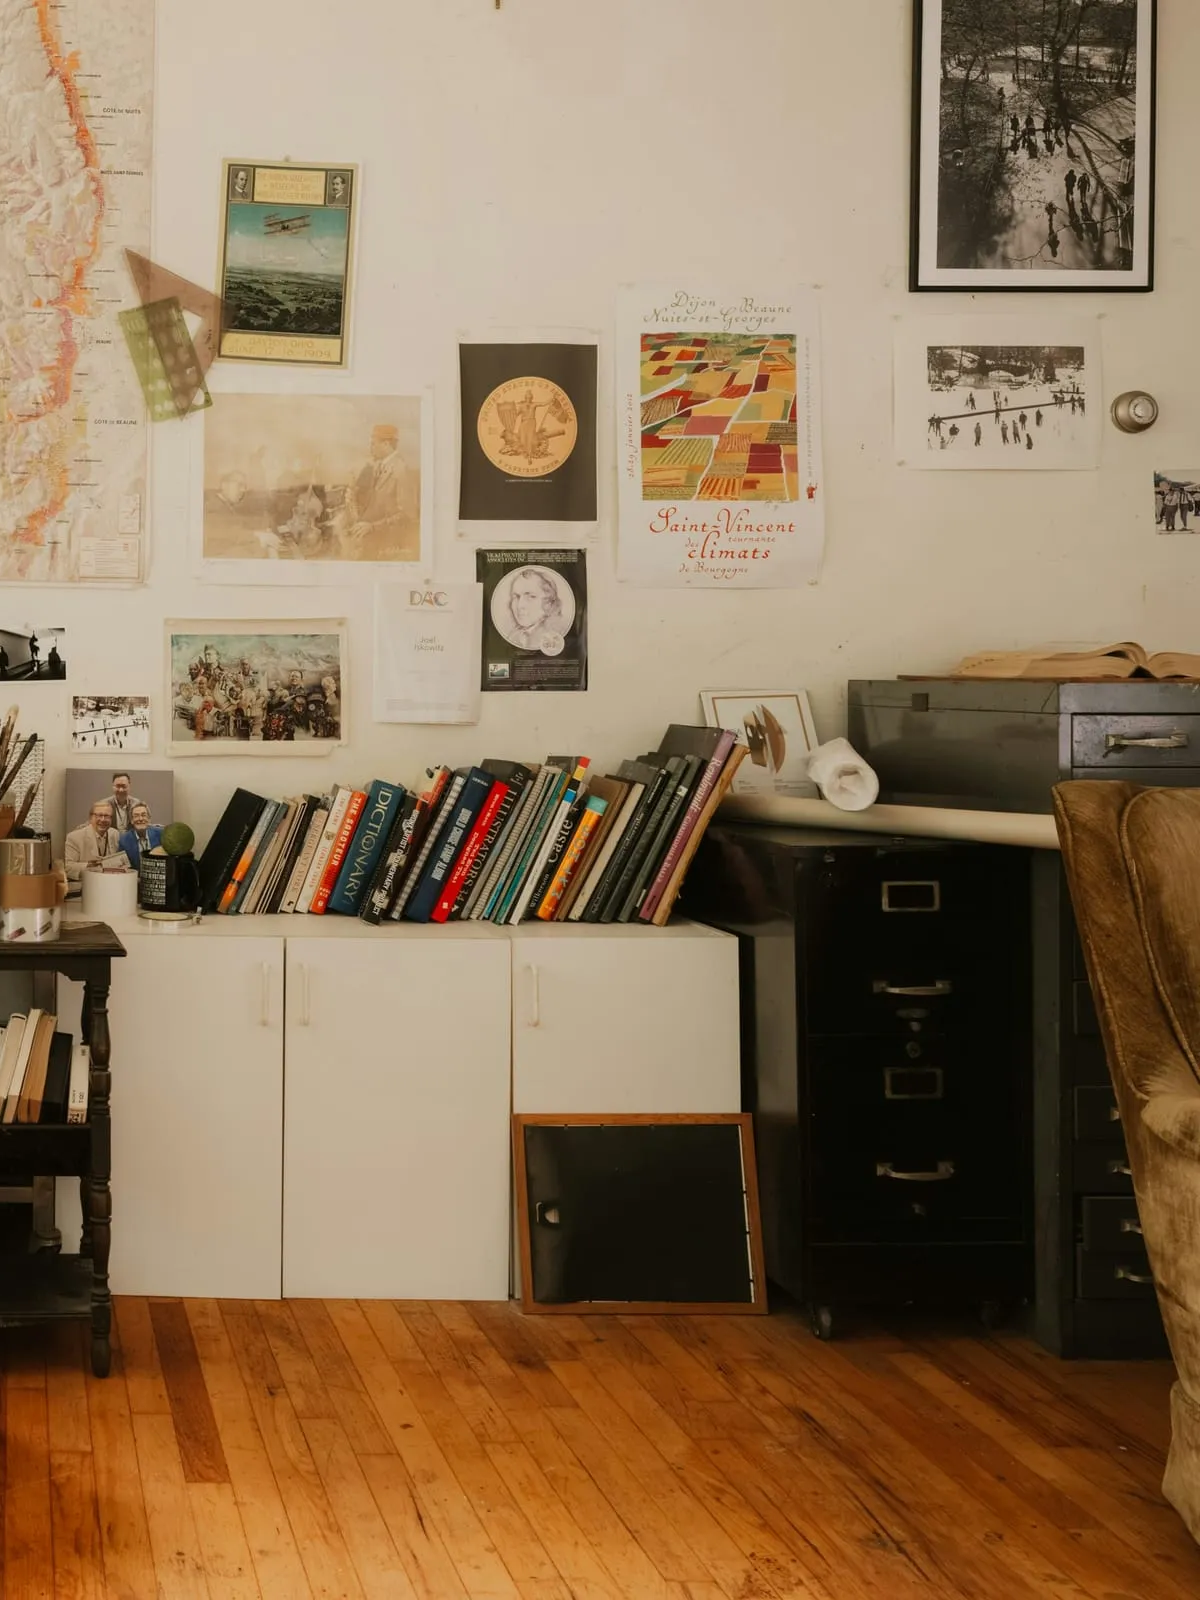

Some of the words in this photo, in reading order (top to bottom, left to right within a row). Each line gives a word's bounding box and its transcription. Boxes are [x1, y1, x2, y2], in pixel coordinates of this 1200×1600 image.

[671, 291, 716, 314] Dijon
[740, 297, 792, 313] Beaune
[650, 506, 796, 534] Saint-Vincent
[688, 531, 770, 559] climats
[694, 562, 748, 580] Bourgogne
[409, 590, 449, 606] DAC
[687, 756, 723, 813] Rembrandt
[348, 796, 362, 815] THE
[330, 817, 354, 867] SABOTEUR
[339, 789, 394, 903] DICTIONARY
[461, 787, 517, 887] ILLUSTRATORS
[546, 817, 574, 865] Caste
